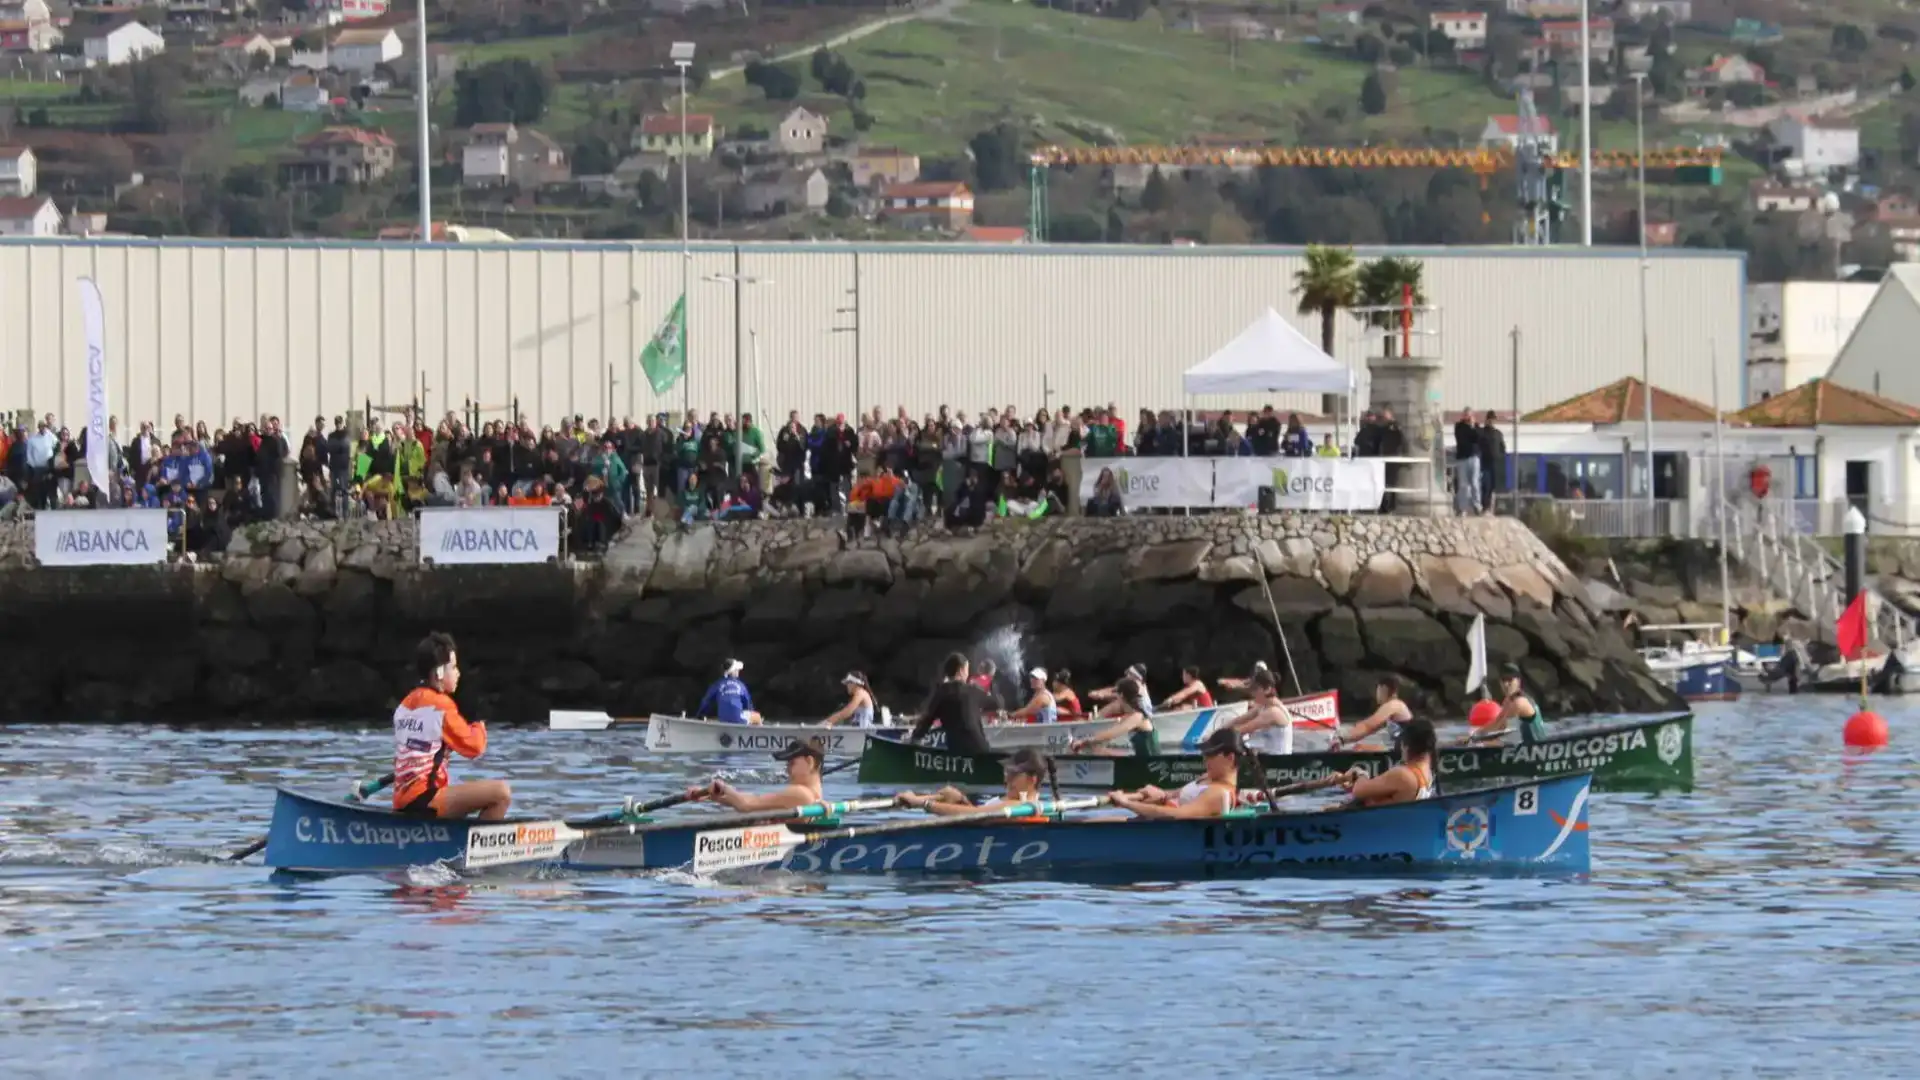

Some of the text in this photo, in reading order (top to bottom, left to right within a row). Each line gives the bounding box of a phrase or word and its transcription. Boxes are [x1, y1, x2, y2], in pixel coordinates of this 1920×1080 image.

[1130, 473, 1160, 492] ence
[1291, 475, 1334, 493] ence
[1501, 728, 1647, 764] FANDICOSTA
[1518, 791, 1534, 810] 8
[295, 815, 316, 843] C.
[349, 820, 450, 849] Chapela
[471, 825, 556, 849] PescaRopa
[699, 829, 781, 853] PescaRopa
[1202, 822, 1342, 848] Torres
[778, 835, 1050, 872] Berete
